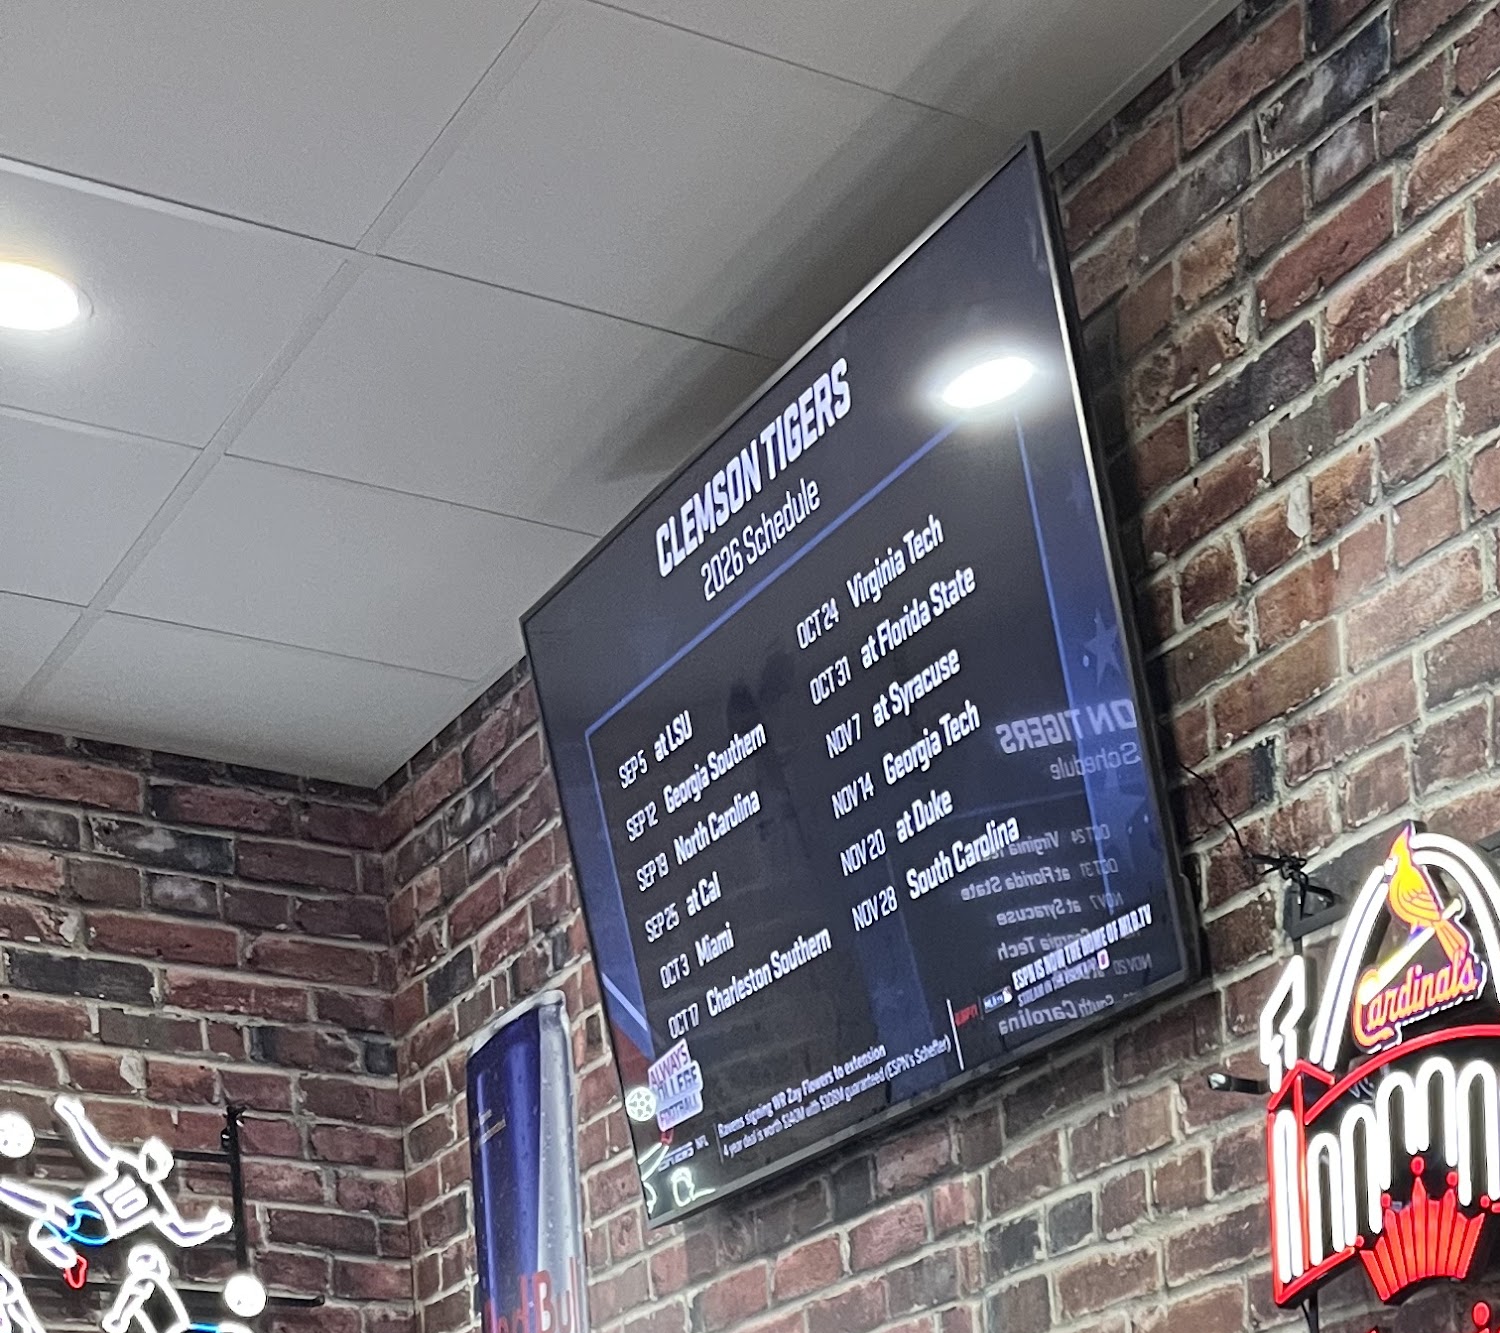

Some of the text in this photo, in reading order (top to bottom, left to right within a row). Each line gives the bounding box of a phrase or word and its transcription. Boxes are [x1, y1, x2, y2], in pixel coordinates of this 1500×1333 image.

[655, 357, 852, 578] CLEMSON TIGERS
[701, 478, 821, 602] 2026 Schedule
[796, 514, 944, 649] OCT 24 Virginia Tech
[809, 566, 976, 705] OCT 31 at Florida State
[618, 709, 693, 789] SEP 5 at LSU
[825, 648, 961, 759] NOV 7 at Syracuse
[626, 809, 646, 842] SEP
[663, 764, 711, 814] Georgia
[707, 723, 767, 781] Southern
[831, 699, 981, 820] NOV 14 Georgia Tech
[636, 861, 657, 892] SEP
[674, 820, 711, 865] North
[707, 790, 761, 842] Carolina
[840, 790, 953, 877] NOV 20 at Duke
[851, 816, 1020, 931] NOV 28 South Carolina
[645, 914, 666, 942] SEP
[686, 888, 702, 916] at
[698, 871, 722, 907] Cal
[659, 921, 735, 989] OCT 3 Miami
[668, 1009, 690, 1039] OCT
[705, 966, 773, 1017] Charleston
[770, 928, 833, 980] Southern
[1352, 948, 1480, 1046] Cardinals
